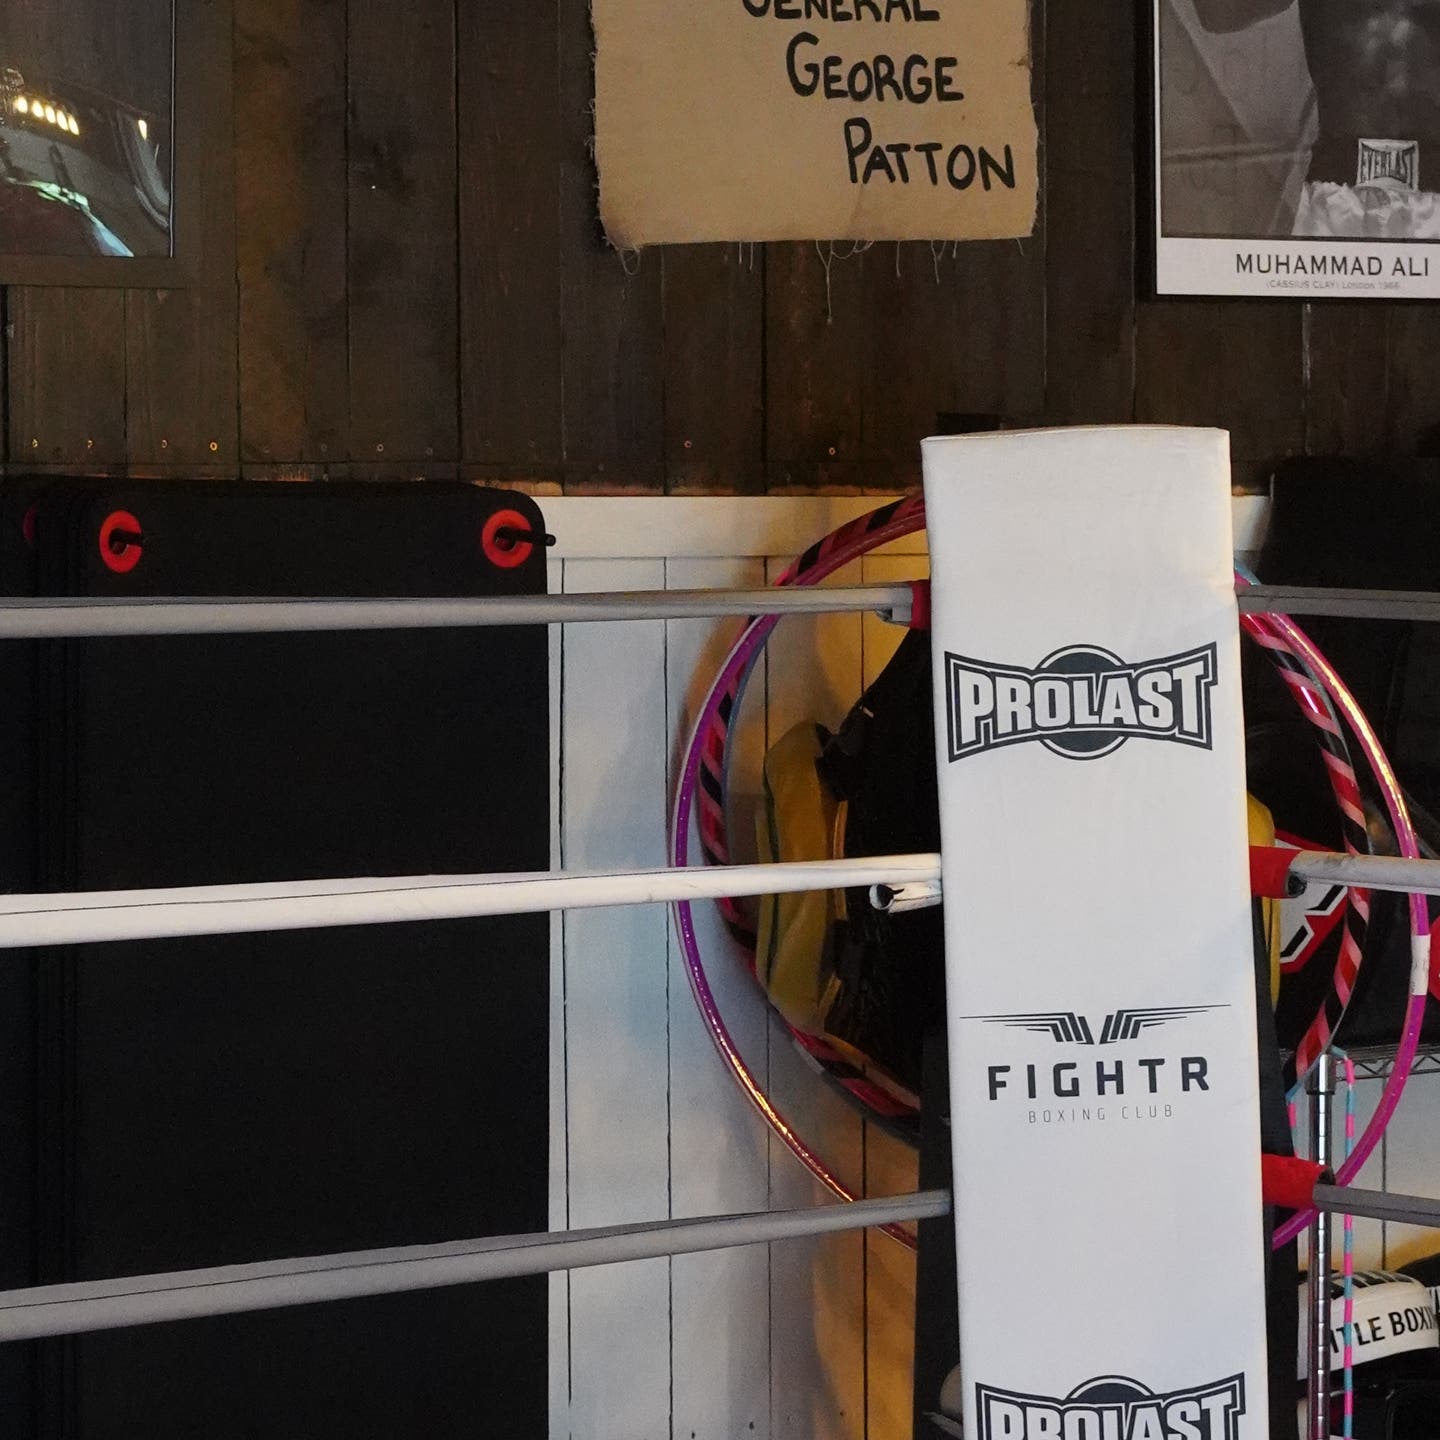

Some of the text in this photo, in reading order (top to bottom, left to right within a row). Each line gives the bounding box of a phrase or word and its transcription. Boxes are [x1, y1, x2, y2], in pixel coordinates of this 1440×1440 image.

[787, 31, 965, 104] GEORGE
[843, 115, 1017, 192] PATTON
[1234, 253, 1430, 278] MUHAMMAD ALI
[959, 662, 1211, 745] PROLAST
[986, 1056, 1211, 1101] FIGHTR
[1028, 1103, 1174, 1125] BOXING CLUB
